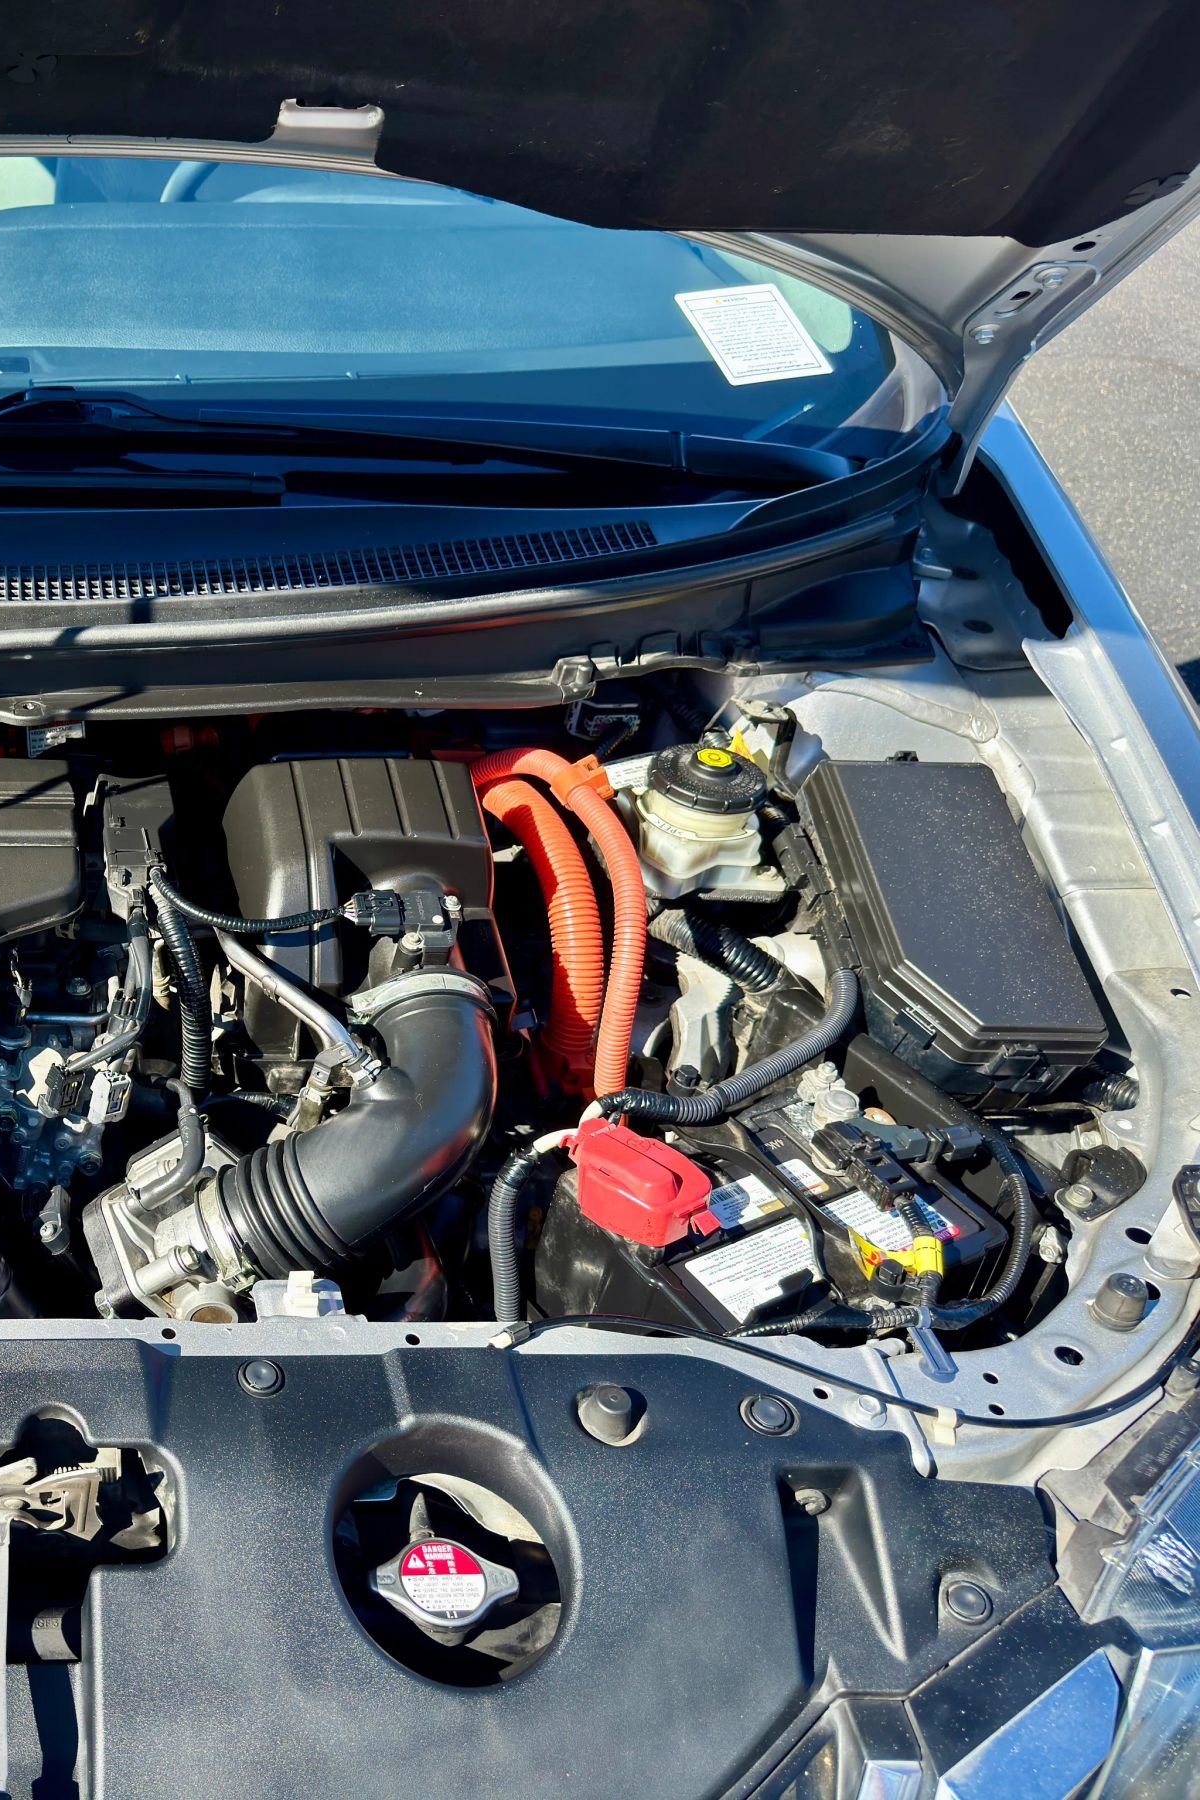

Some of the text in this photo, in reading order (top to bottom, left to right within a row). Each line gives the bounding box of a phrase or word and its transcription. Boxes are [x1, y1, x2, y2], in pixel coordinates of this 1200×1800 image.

[421, 1545, 453, 1553] DANGER
[423, 1552, 455, 1560] WARNING
[446, 1610, 458, 1619] 1.1
